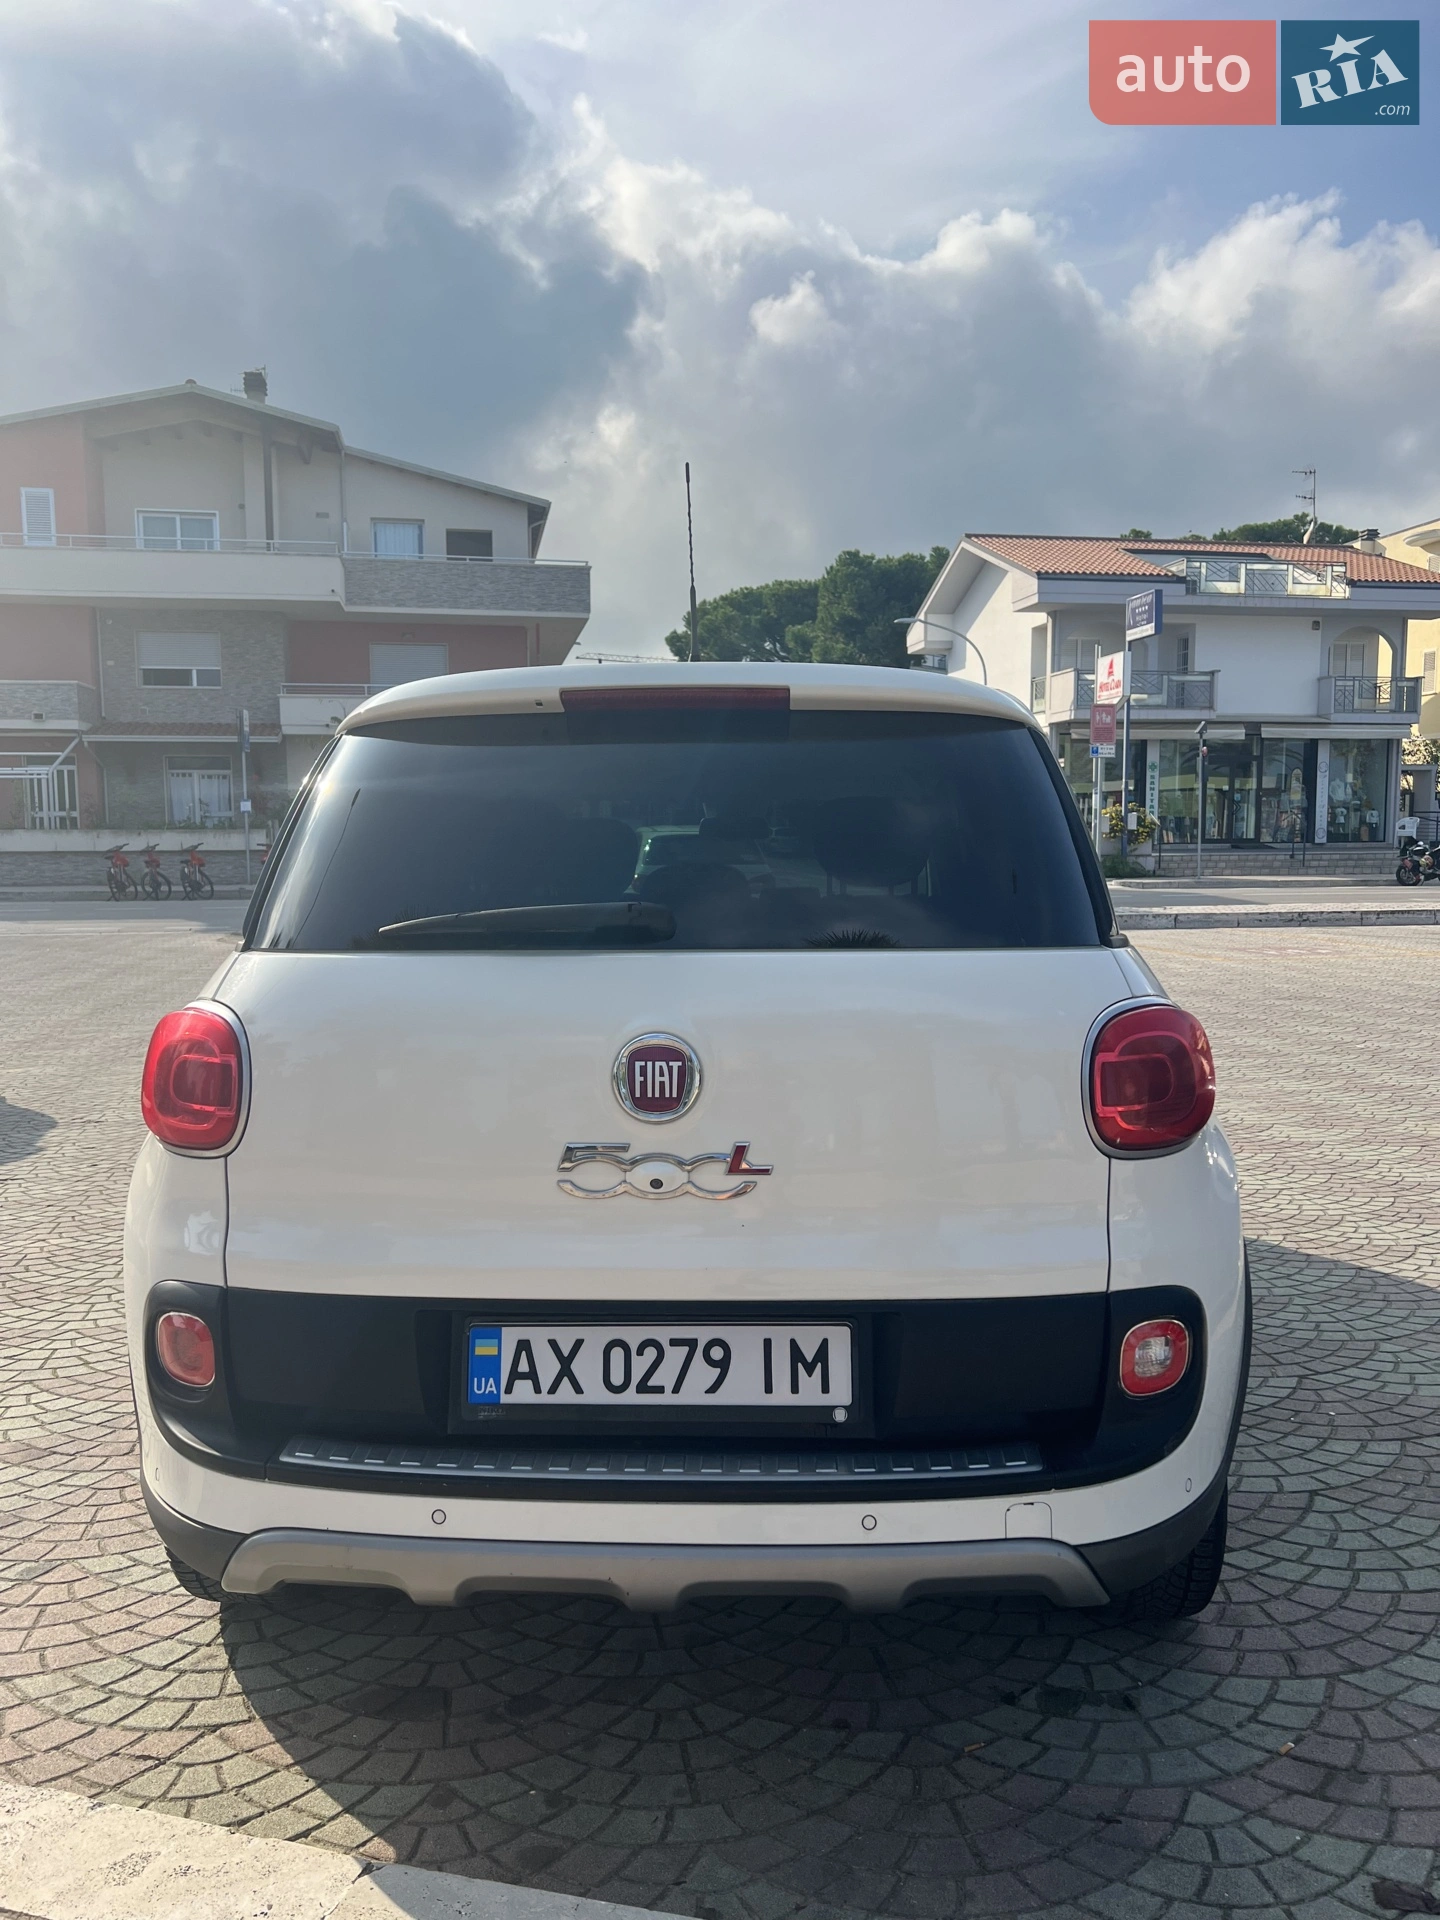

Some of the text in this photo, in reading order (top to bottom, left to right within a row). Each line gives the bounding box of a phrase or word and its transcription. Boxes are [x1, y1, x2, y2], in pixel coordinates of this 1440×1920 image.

[634, 1061, 683, 1098] FIAT
[557, 1141, 775, 1200] 500L
[473, 1377, 498, 1395] UA
[504, 1337, 830, 1395] AX 0279 IM
